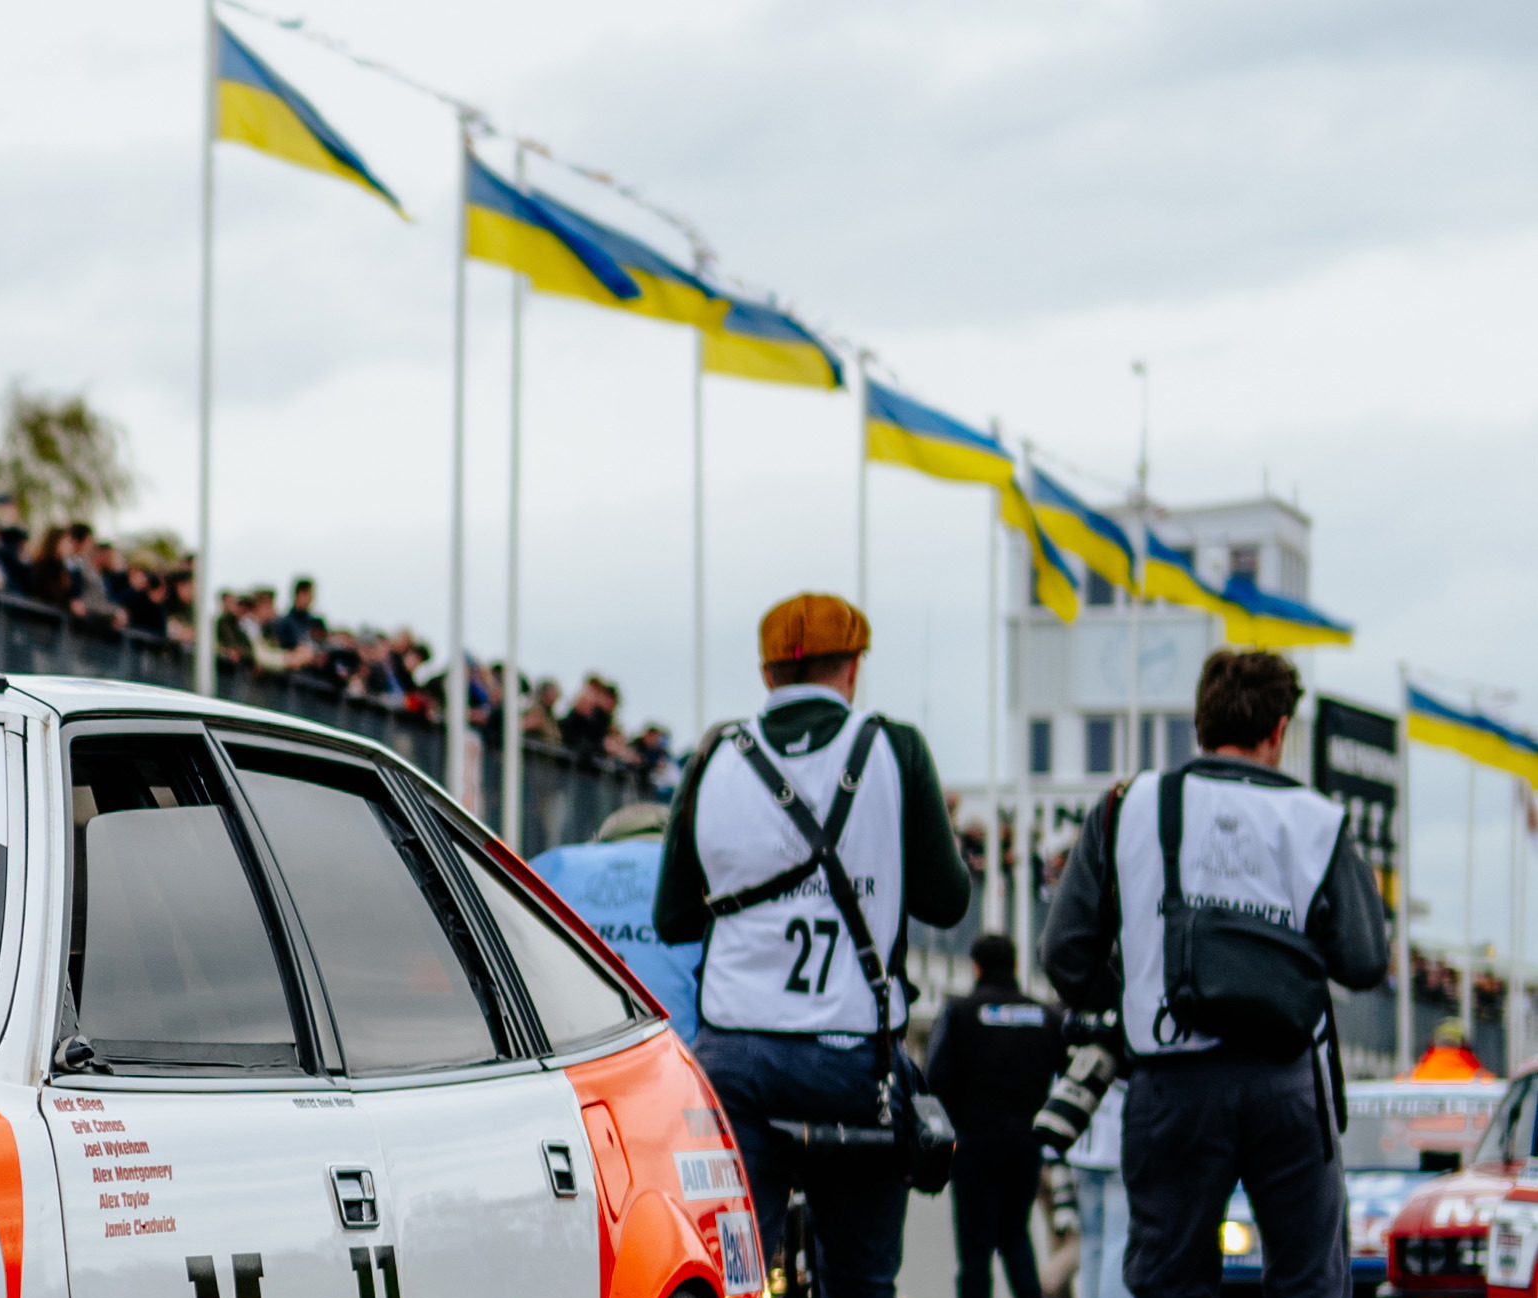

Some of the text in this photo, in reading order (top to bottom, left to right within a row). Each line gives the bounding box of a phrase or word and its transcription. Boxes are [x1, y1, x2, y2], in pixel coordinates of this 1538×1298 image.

[589, 922, 662, 945] RAC
[784, 916, 839, 995] 27
[53, 1096, 105, 1112] Nick Sleep
[71, 1119, 126, 1134] Erik Comas
[83, 1140, 150, 1157] Joel Wykeham
[92, 1165, 173, 1183] Alex Montgomery
[99, 1191, 150, 1209] Alex Taylor
[105, 1216, 177, 1238] Jamie Chadwick
